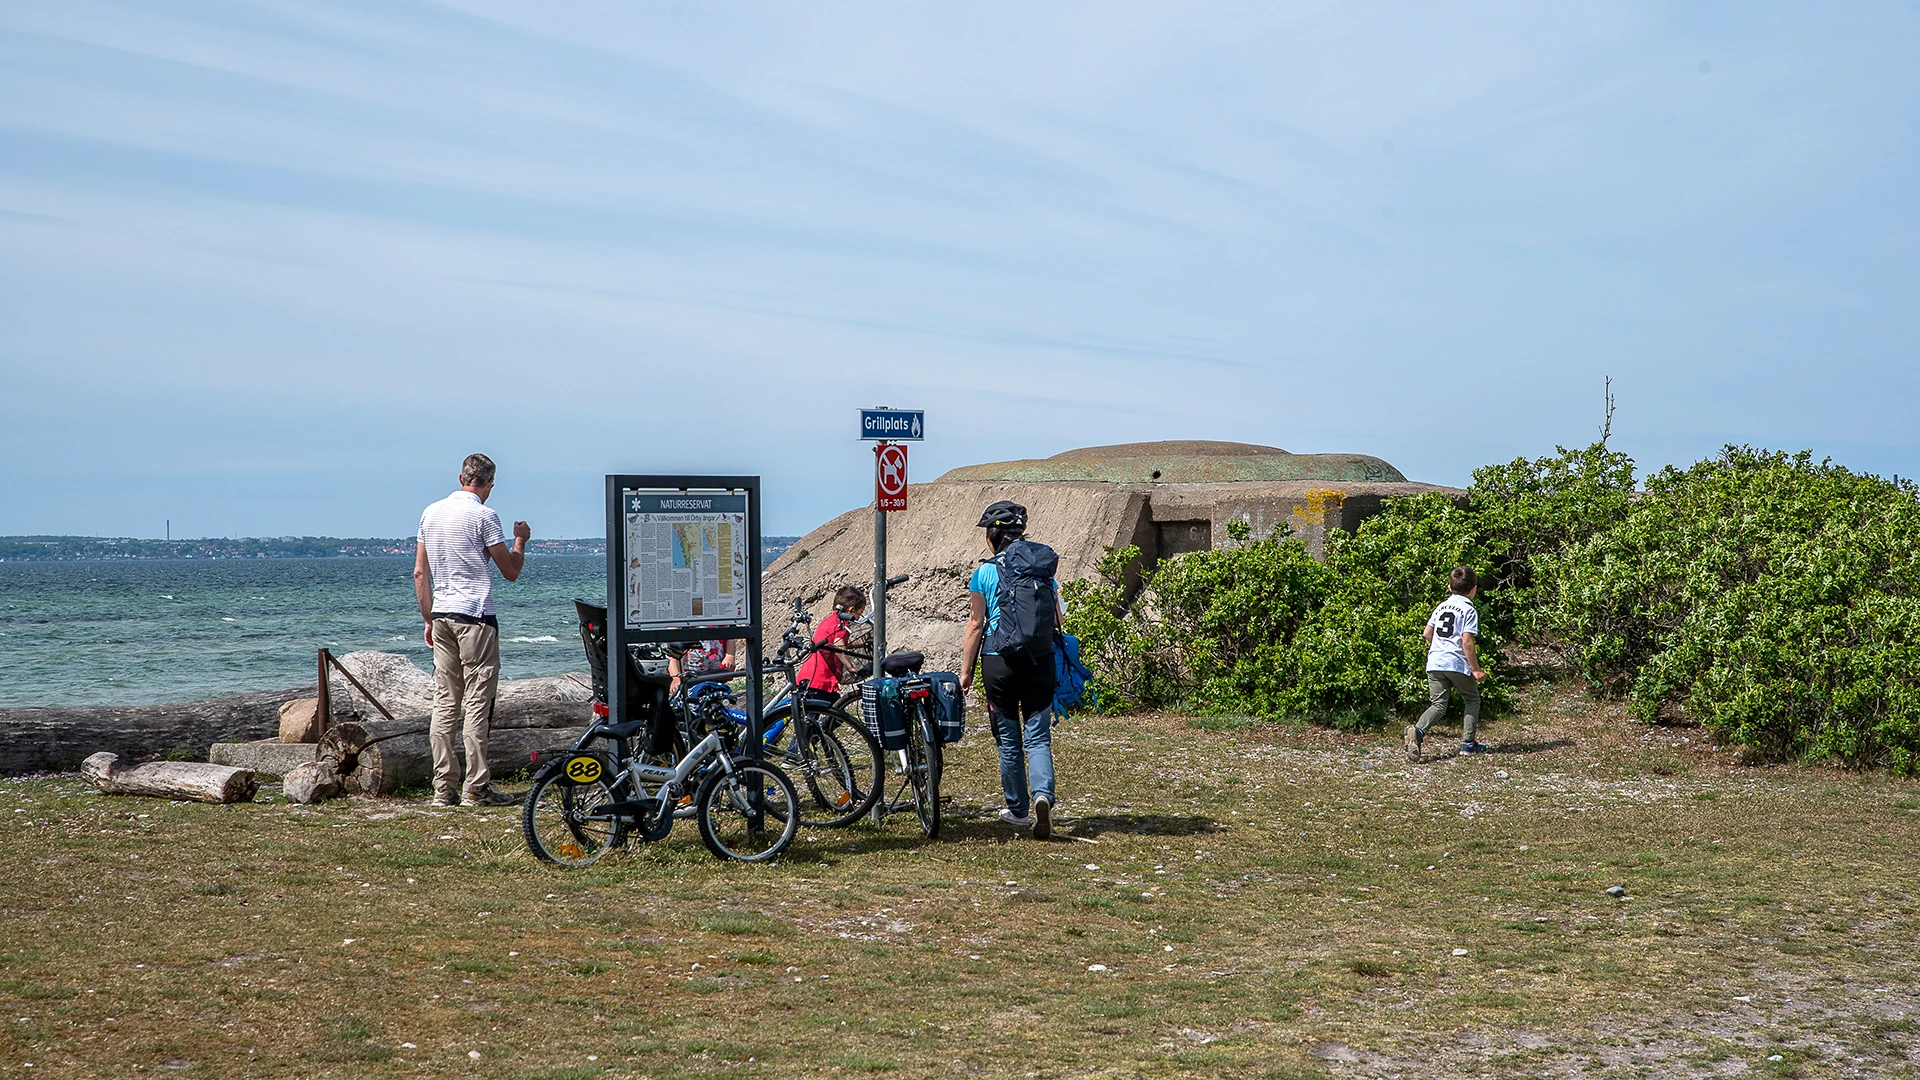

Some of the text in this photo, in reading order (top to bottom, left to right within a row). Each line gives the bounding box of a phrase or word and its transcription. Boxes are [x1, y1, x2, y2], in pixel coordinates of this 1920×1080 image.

[865, 416, 909, 433] Grillplats
[660, 499, 712, 509] NATURRESERVAT
[1436, 611, 1455, 638] 3
[569, 761, 599, 777] 88
[642, 768, 667, 777] PEAK
